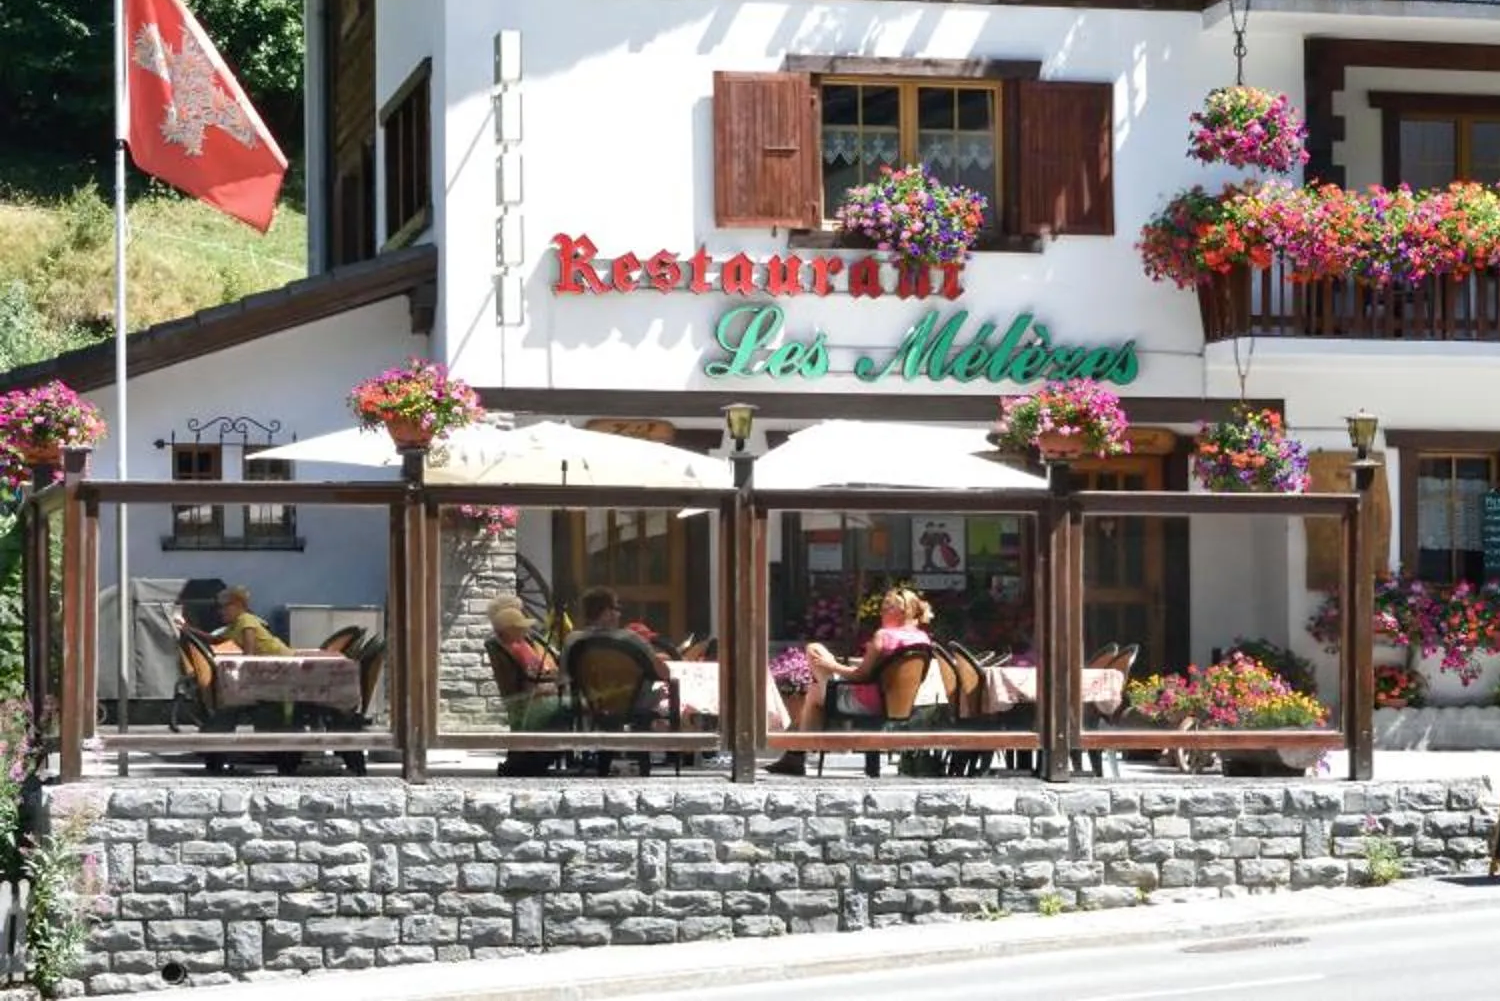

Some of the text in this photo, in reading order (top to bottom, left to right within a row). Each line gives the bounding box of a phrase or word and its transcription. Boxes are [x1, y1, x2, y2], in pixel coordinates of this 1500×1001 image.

[551, 232, 965, 301] Restaurant
[703, 304, 1140, 385] Les Mélèzes
